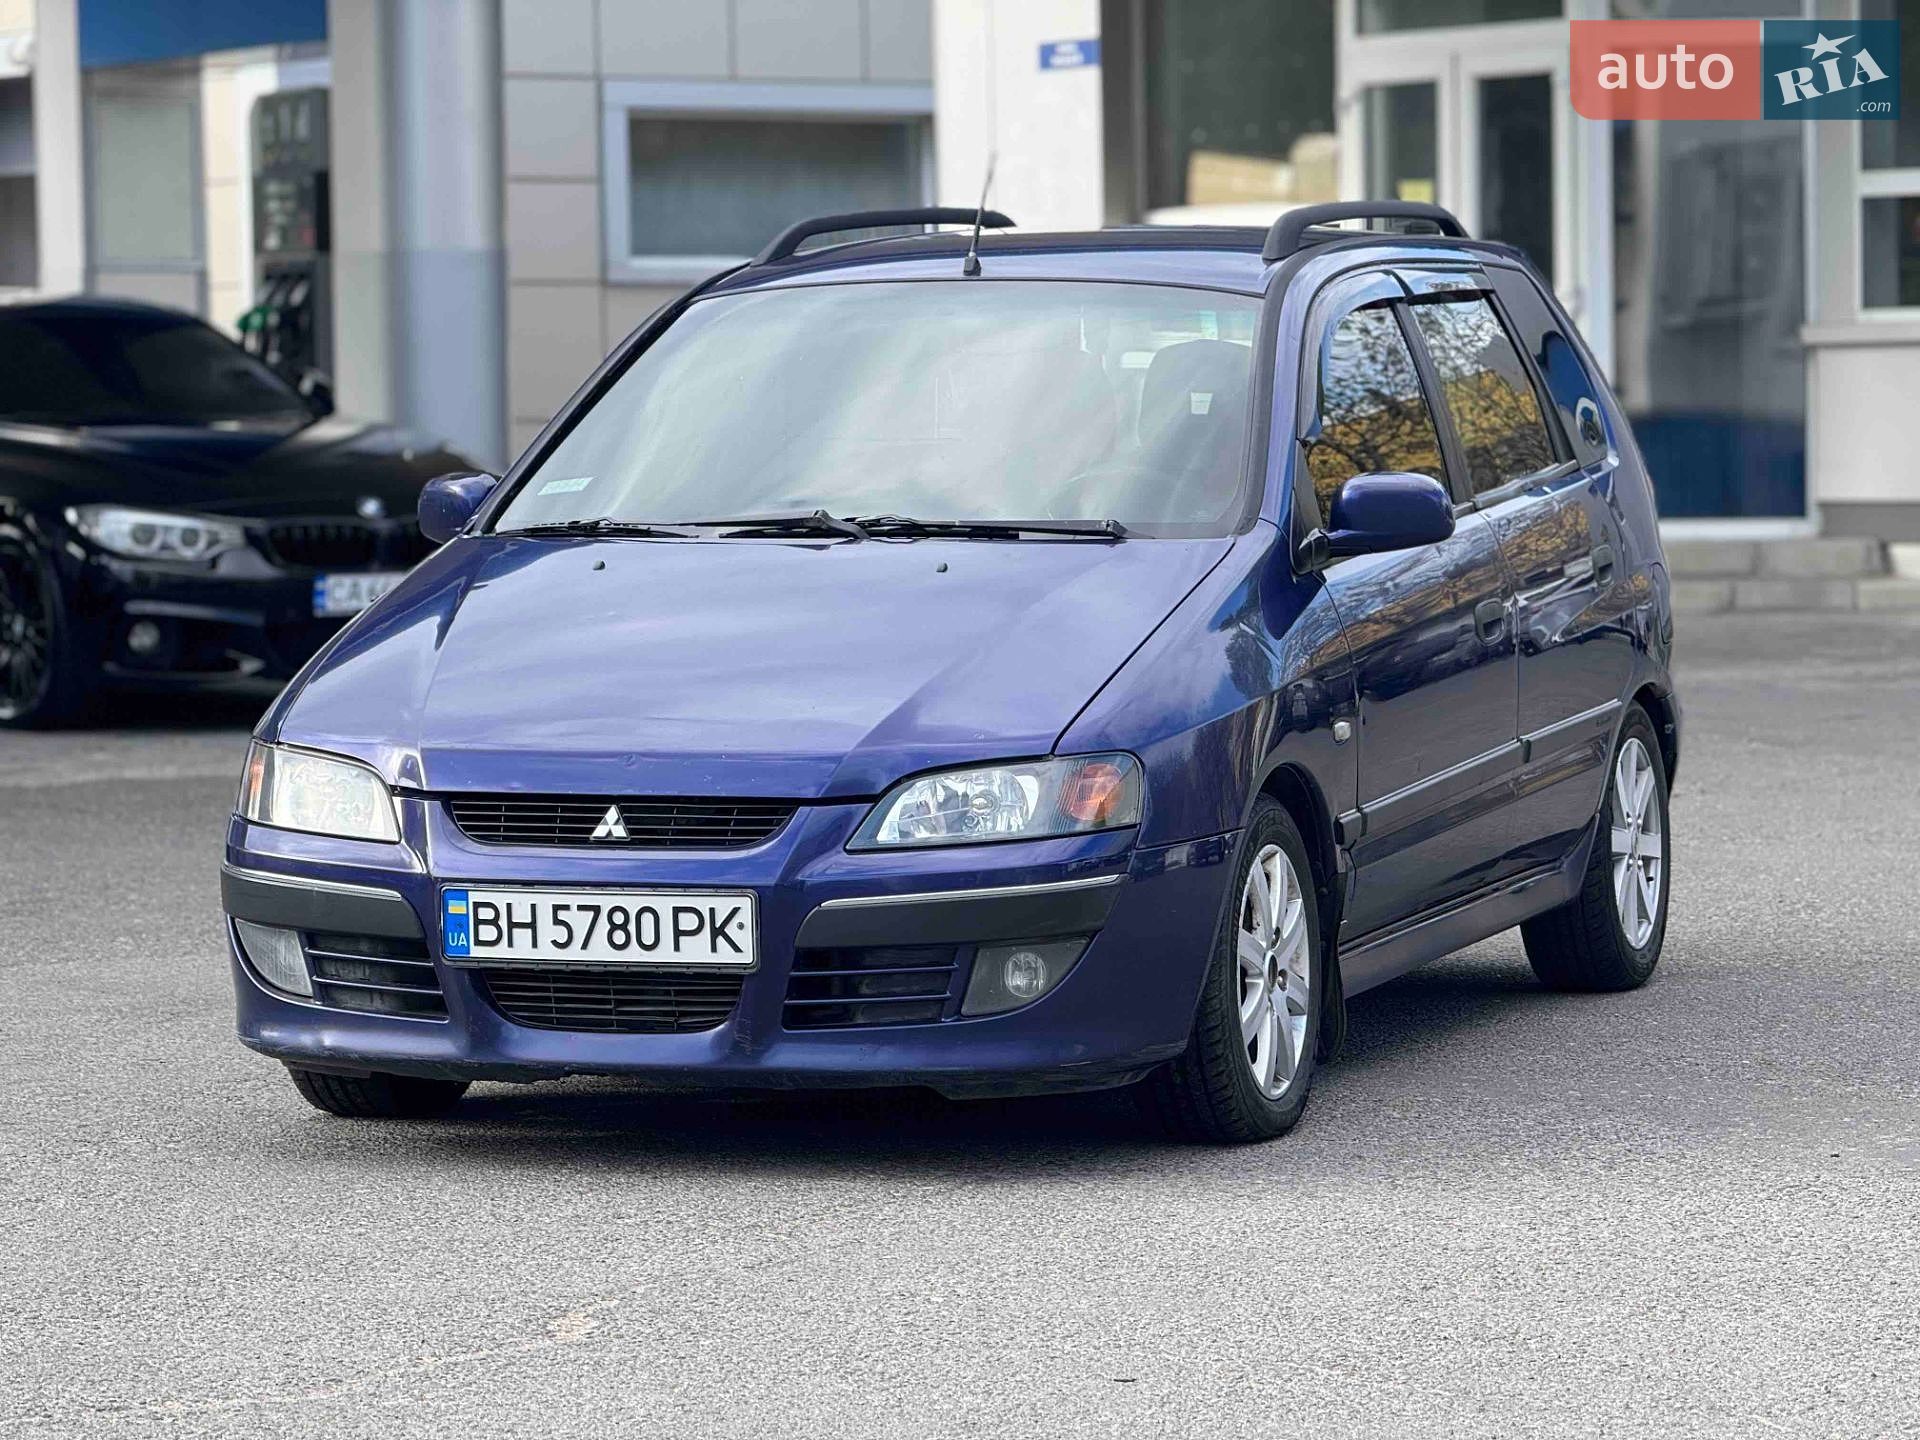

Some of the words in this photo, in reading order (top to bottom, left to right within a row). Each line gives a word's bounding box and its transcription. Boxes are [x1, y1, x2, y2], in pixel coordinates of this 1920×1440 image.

[448, 932, 468, 947] UA
[472, 901, 538, 949] BH
[550, 904, 660, 951] 5780
[672, 906, 744, 953] PK
